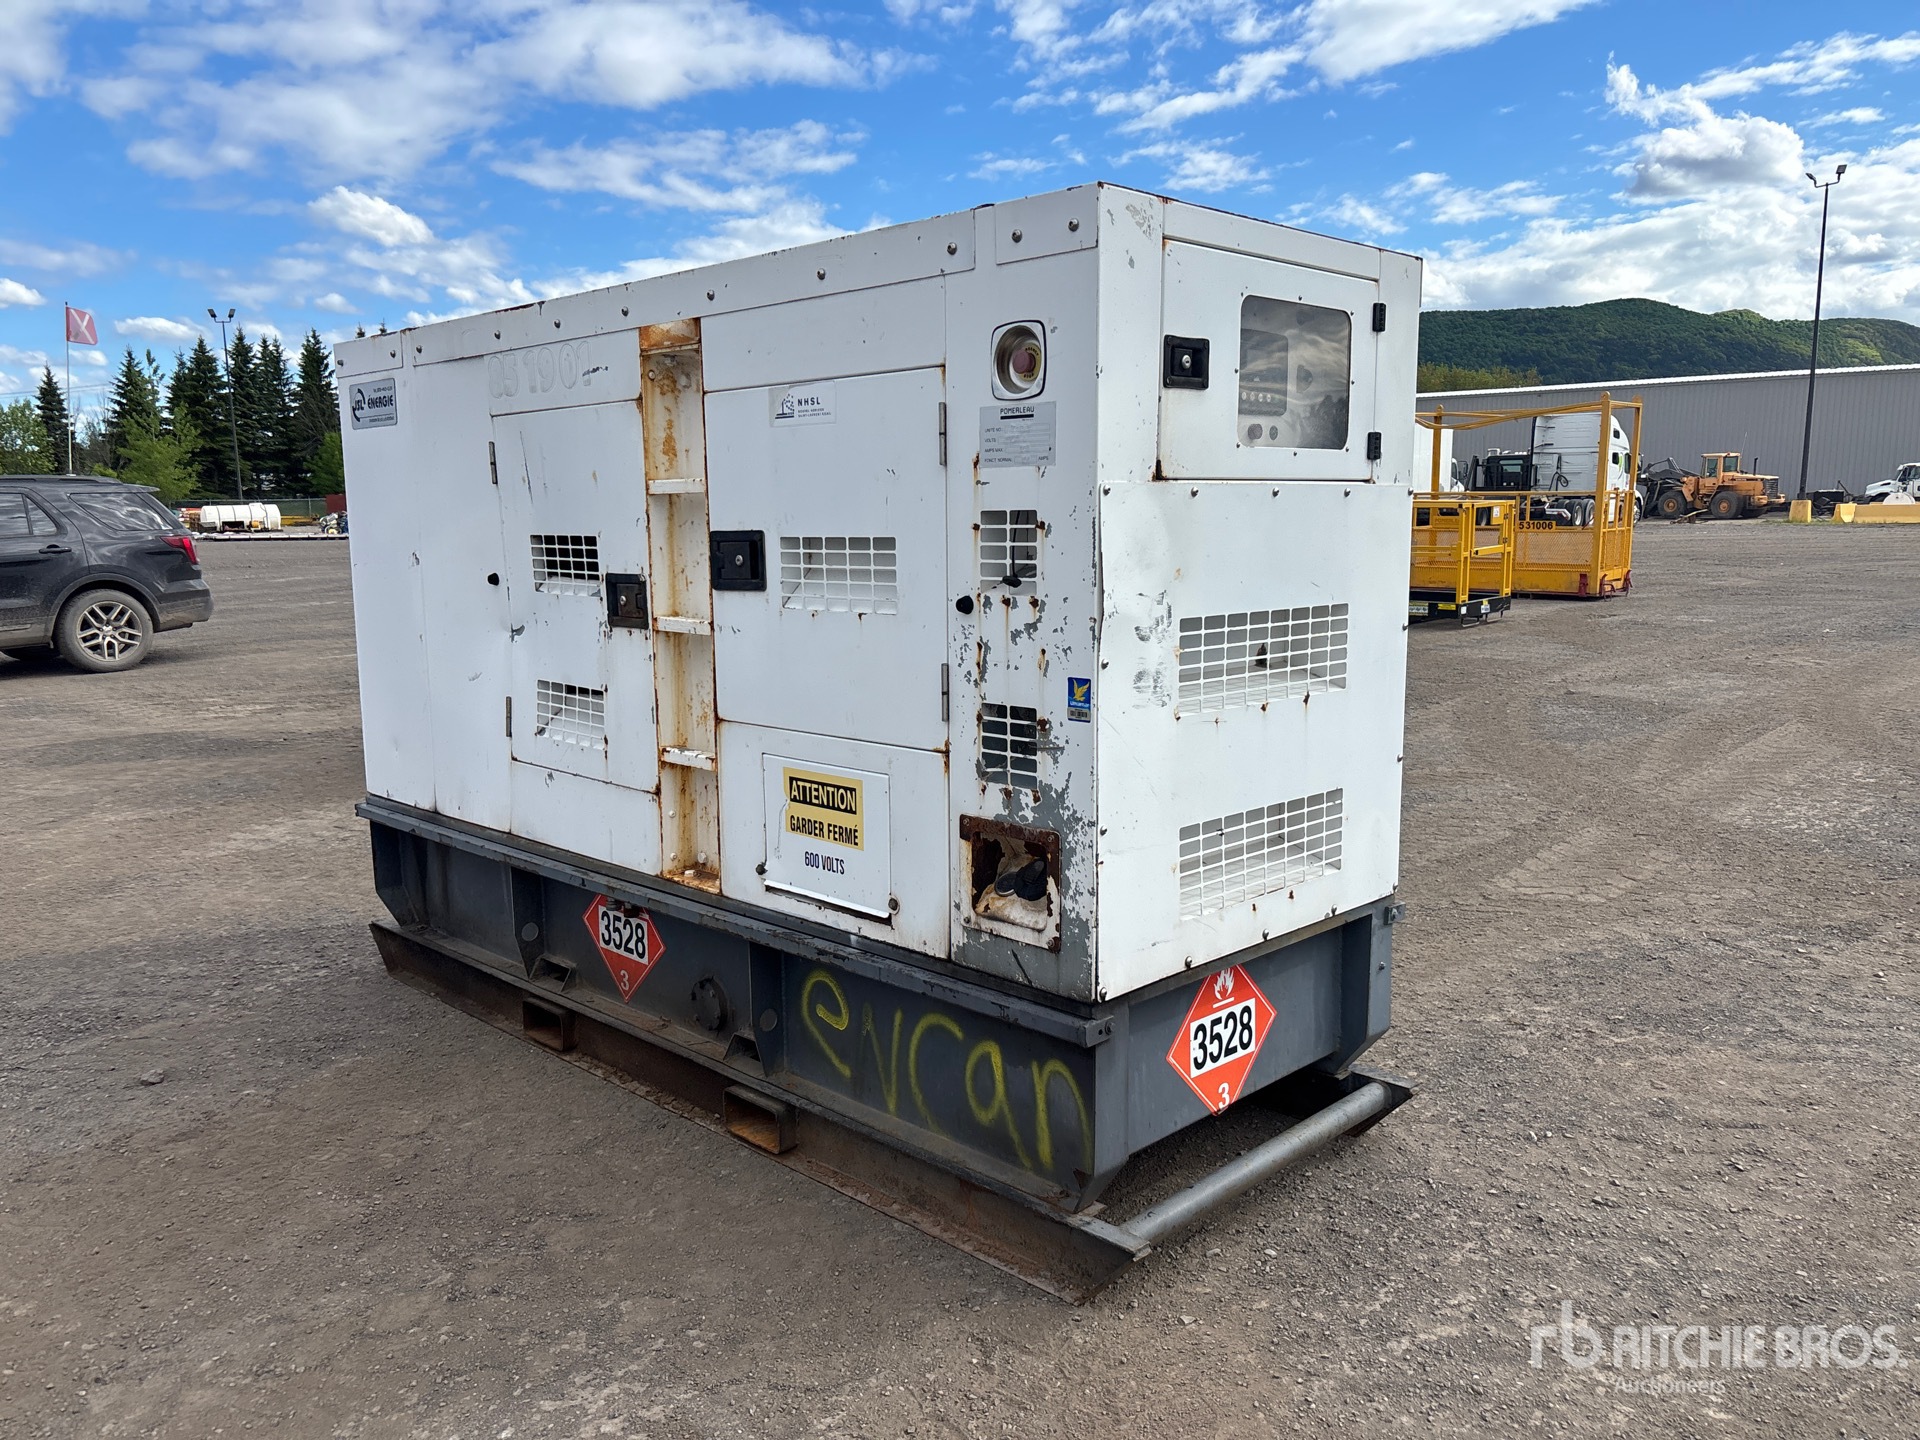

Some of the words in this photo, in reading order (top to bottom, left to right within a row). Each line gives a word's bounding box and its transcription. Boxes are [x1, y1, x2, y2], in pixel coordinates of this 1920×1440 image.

[367, 395, 394, 409] ÉNERGIE
[797, 397, 821, 407] NHSL
[1000, 406, 1035, 415] POMERLEAU
[1518, 521, 1554, 530] 531006
[791, 780, 856, 812] ATTENTION
[790, 815, 825, 839] GARDER
[827, 823, 859, 847] FERMÉ
[804, 850, 820, 869] 600
[821, 854, 845, 875] VOLTS
[601, 910, 646, 960] 3528
[620, 969, 630, 991] 3
[1193, 1005, 1253, 1071] 3528
[1218, 1082, 1230, 1109] 3
